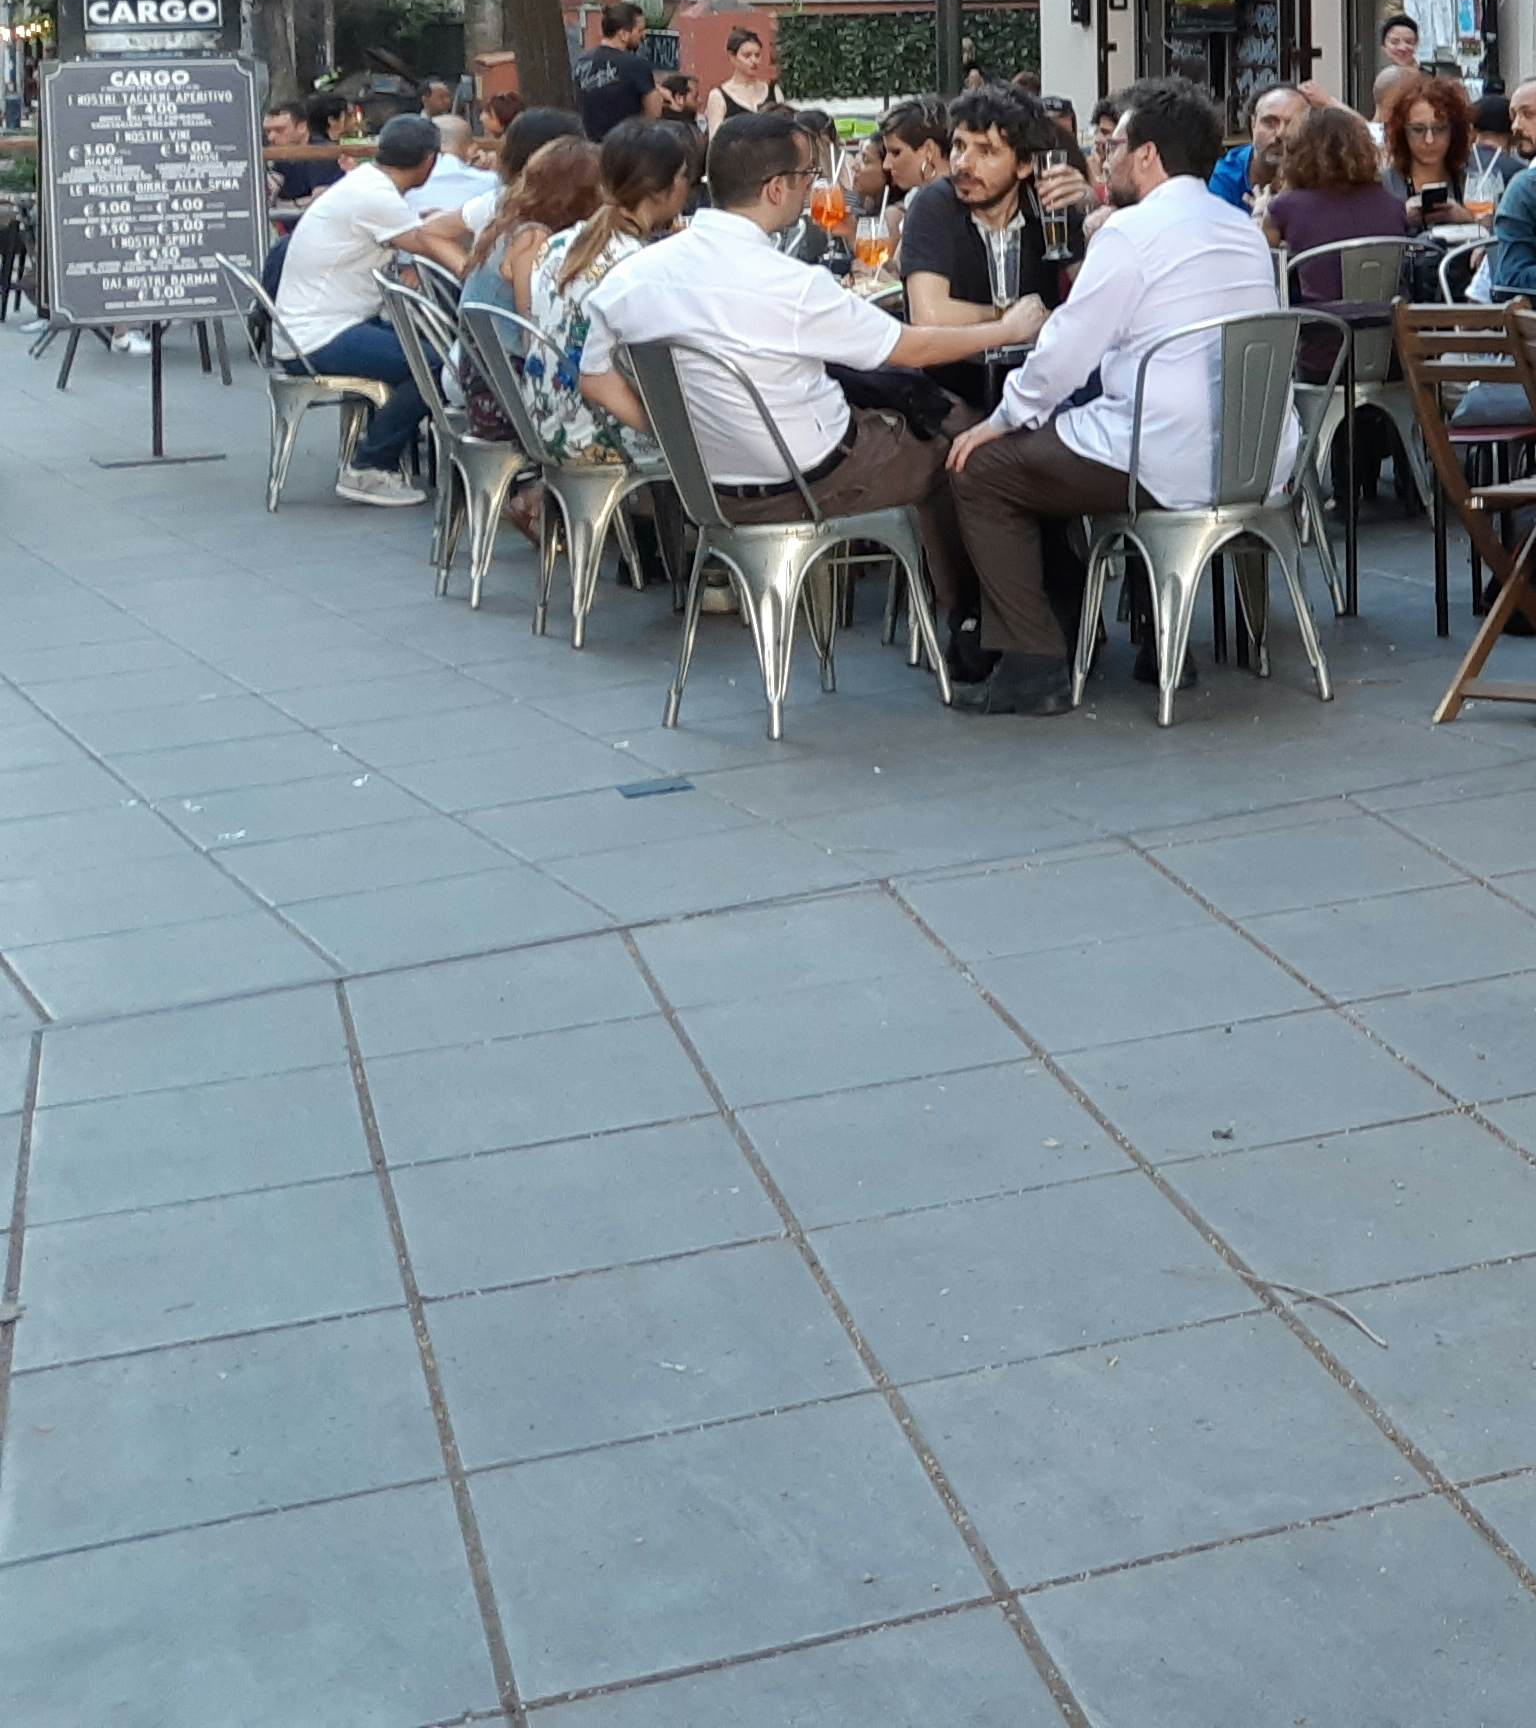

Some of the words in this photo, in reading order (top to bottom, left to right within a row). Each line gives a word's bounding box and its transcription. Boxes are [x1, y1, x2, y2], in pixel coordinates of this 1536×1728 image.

[110, 69, 190, 86] CARGO
[175, 89, 233, 105] APERITIVO
[124, 131, 165, 143] NOSTRI
[168, 129, 191, 141] VINI
[174, 179, 203, 192] ALLA
[165, 233, 204, 247] SPRITZ
